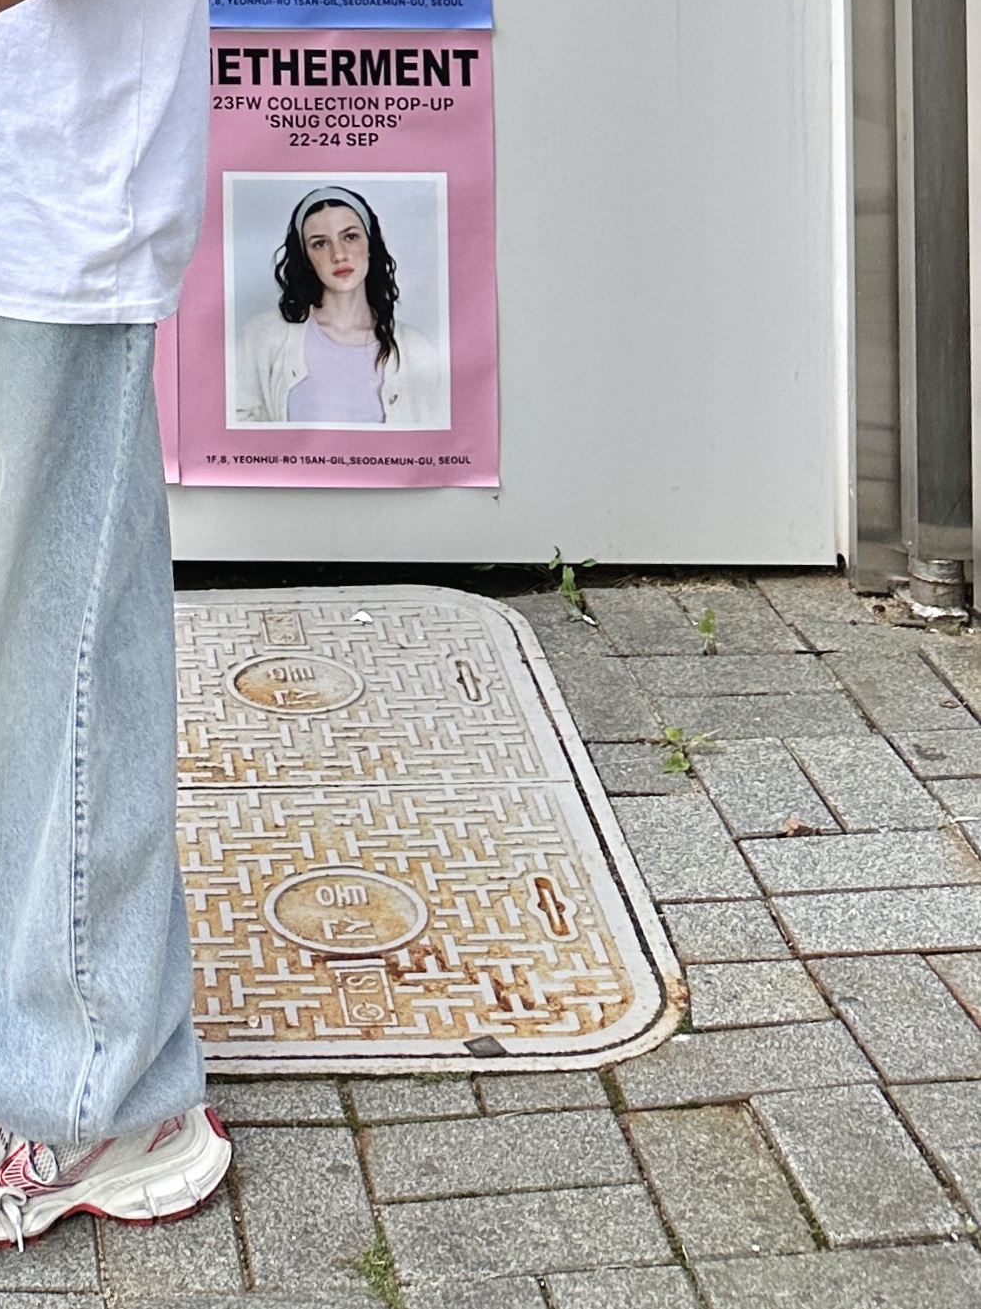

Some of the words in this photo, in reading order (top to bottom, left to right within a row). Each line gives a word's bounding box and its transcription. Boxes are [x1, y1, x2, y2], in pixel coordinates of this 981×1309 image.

[209, 48, 480, 87] ETHERMENT
[213, 95, 261, 110] 23FW
[267, 96, 379, 110] COLLECTION
[384, 97, 453, 111] POP-UP
[265, 114, 320, 128] 'SNUG
[325, 114, 401, 128] COLORS'
[289, 132, 340, 146] 22-24
[346, 132, 378, 146] SEP
[438, 456, 471, 464] SEOUL
